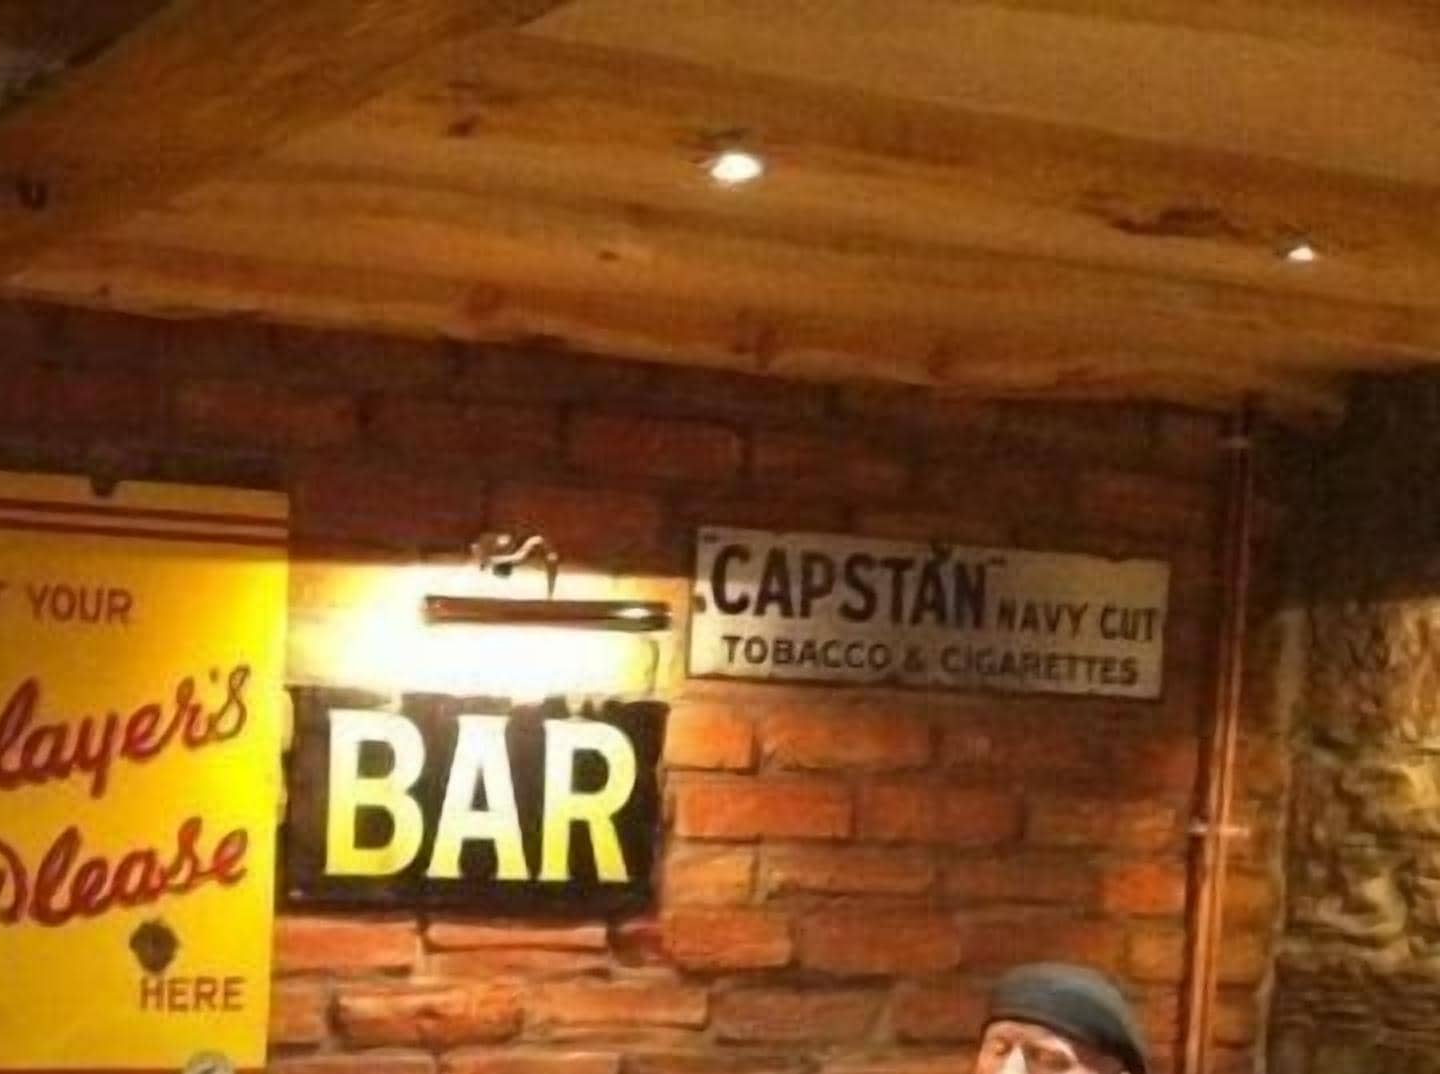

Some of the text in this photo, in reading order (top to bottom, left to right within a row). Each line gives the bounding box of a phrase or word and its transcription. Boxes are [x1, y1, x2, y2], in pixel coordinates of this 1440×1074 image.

[26, 584, 134, 625] YOUR
[996, 602, 1089, 641] NAVY
[1099, 604, 1157, 642] CUT
[721, 634, 1139, 687] TOBACCO & CIGARETTES
[324, 708, 637, 883] BAR
[138, 976, 246, 1012] HERE
